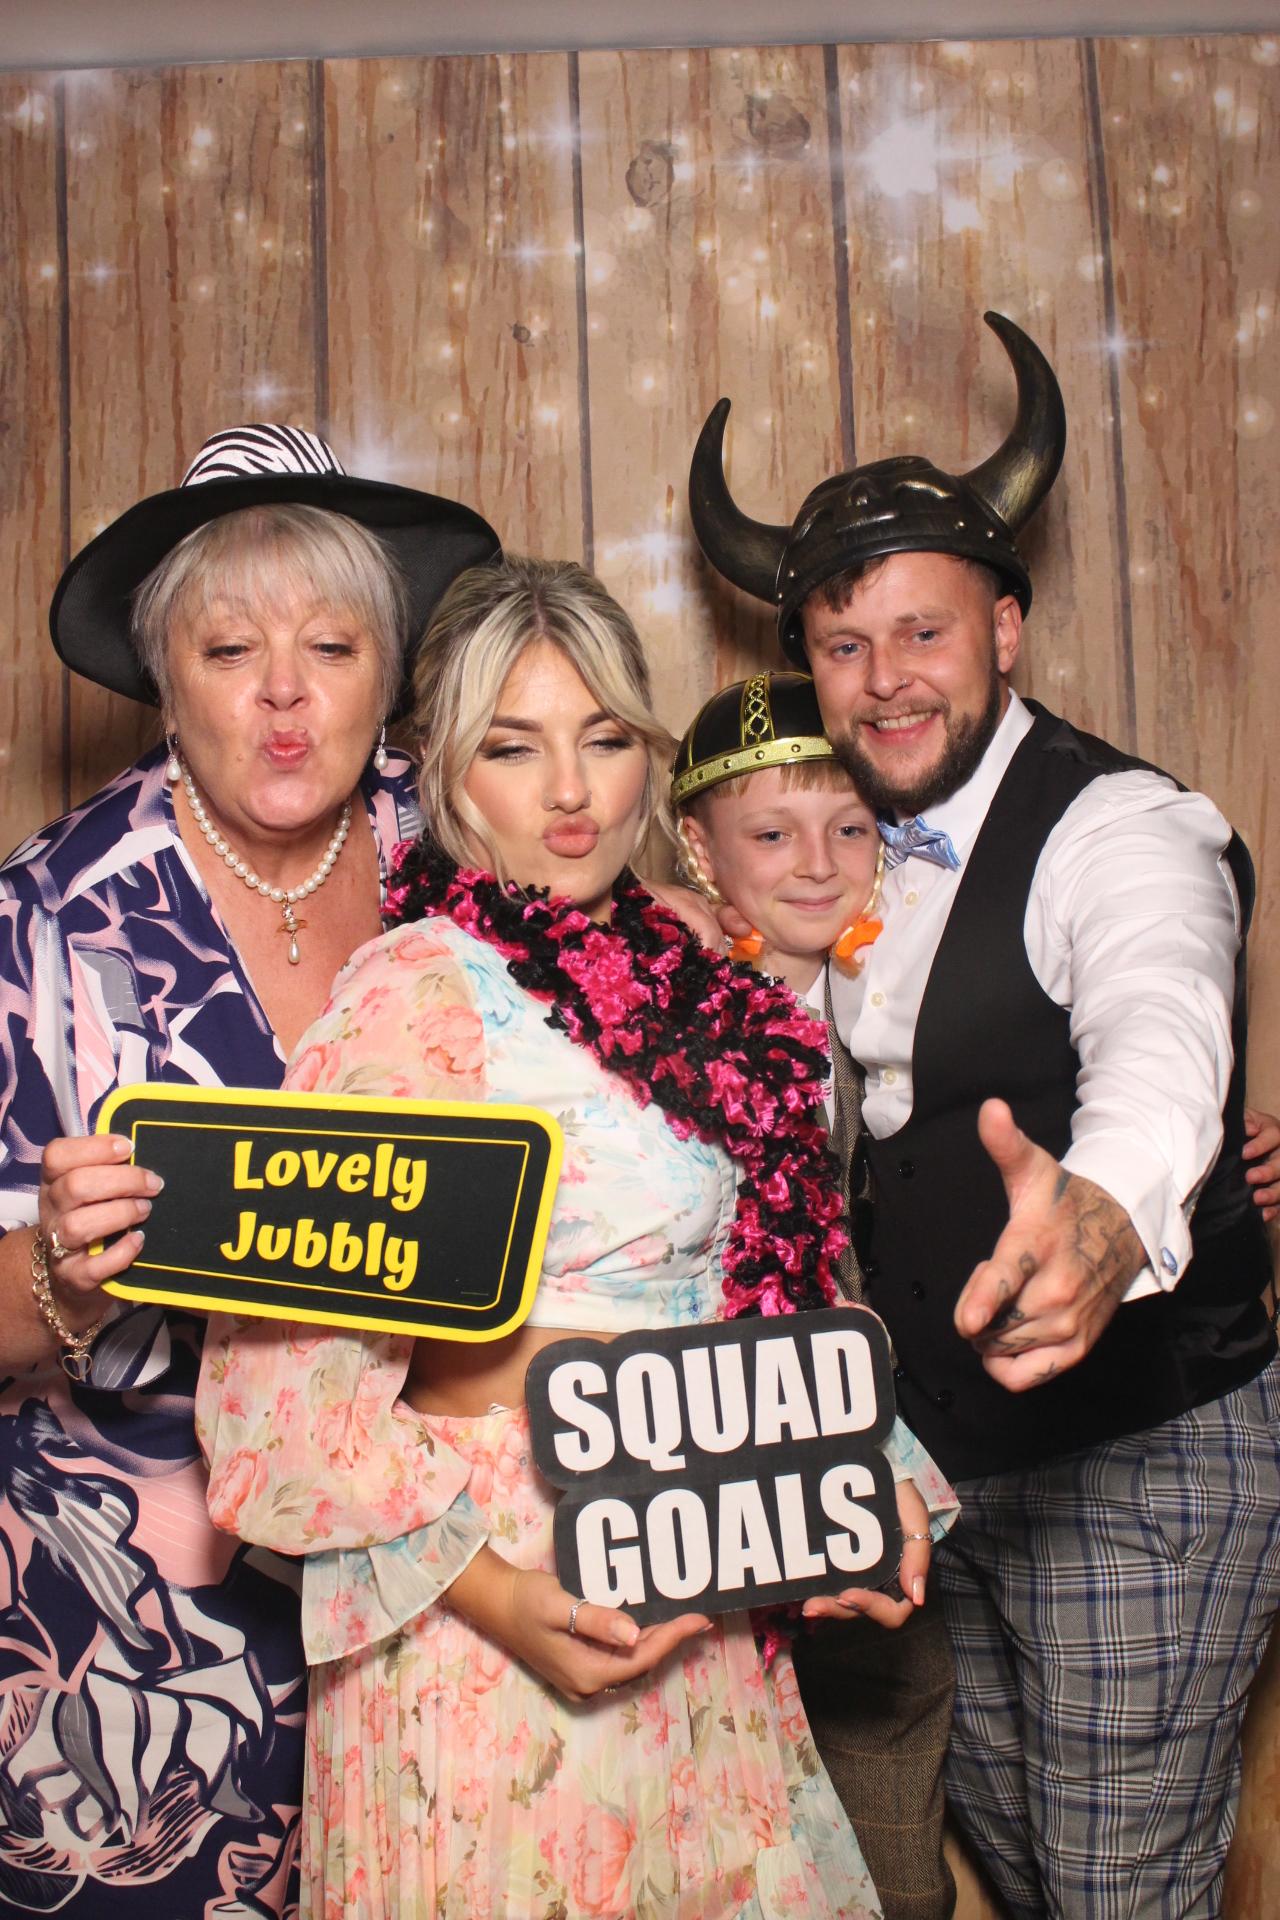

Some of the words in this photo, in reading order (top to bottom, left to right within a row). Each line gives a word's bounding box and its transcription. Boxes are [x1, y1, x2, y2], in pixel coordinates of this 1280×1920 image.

[233, 1141, 427, 1211] Lovely
[220, 1211, 419, 1291] Jubbly
[548, 1330, 877, 1471] SQUAD
[576, 1464, 884, 1609] GOALS
